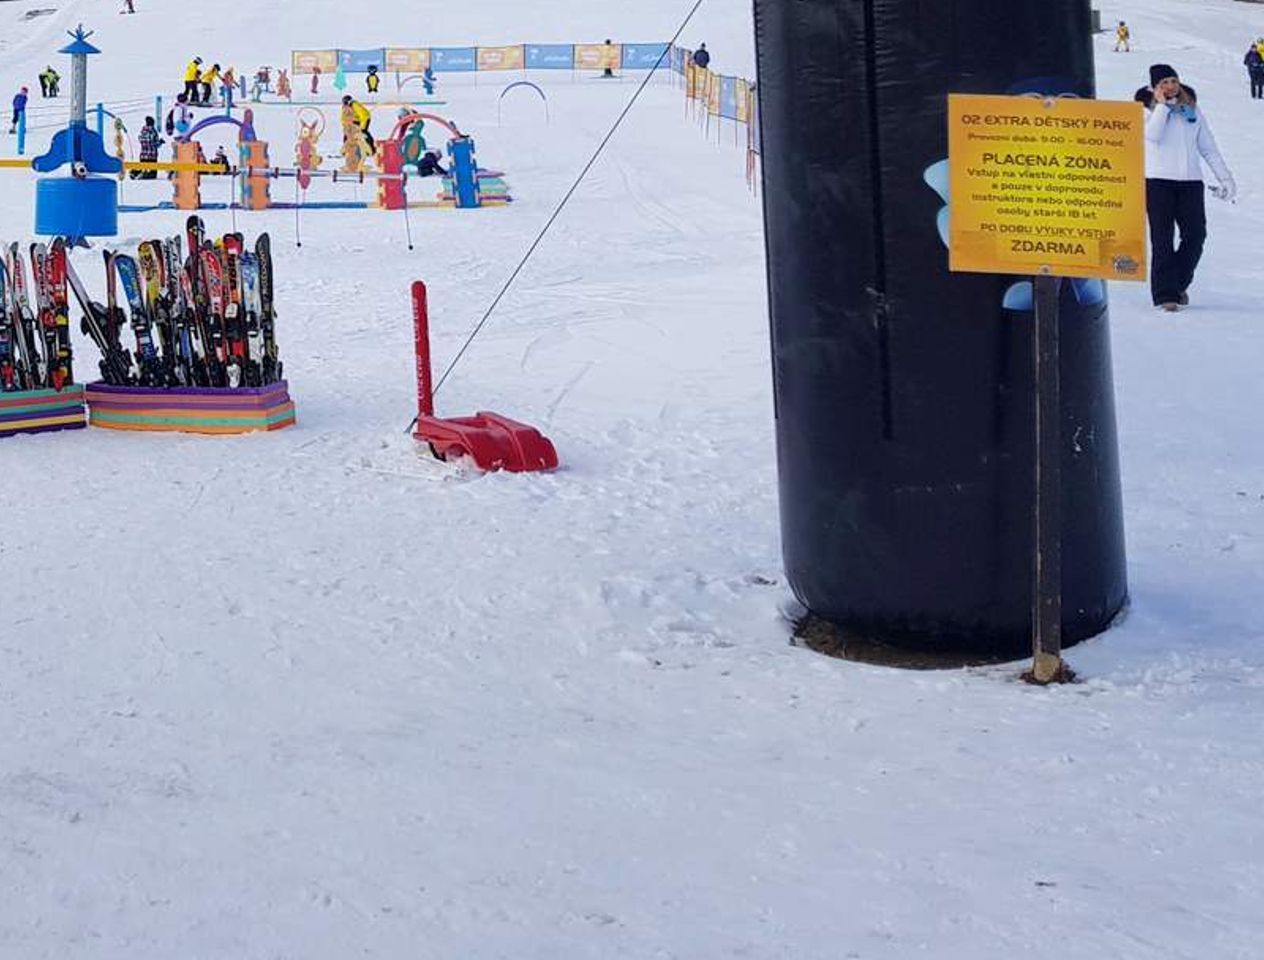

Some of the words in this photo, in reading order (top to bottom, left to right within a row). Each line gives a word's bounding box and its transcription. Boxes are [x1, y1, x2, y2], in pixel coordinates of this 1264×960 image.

[984, 115, 1031, 126] EXTRA
[1093, 119, 1132, 131] PARK
[982, 152, 1060, 167] PLACENÁ
[1064, 154, 1112, 170] ZÓNA
[967, 168, 1000, 178] Vstup
[1001, 183, 1033, 192] pouze
[1045, 184, 1104, 195] doprovodu
[1036, 196, 1063, 205] nebo
[997, 207, 1031, 217] osoby
[1069, 210, 1080, 219] 18
[980, 222, 997, 232] PO
[1000, 223, 1032, 233] DOBU
[1077, 227, 1117, 239] VSTUP
[1010, 239, 1086, 255] ZDARMA
